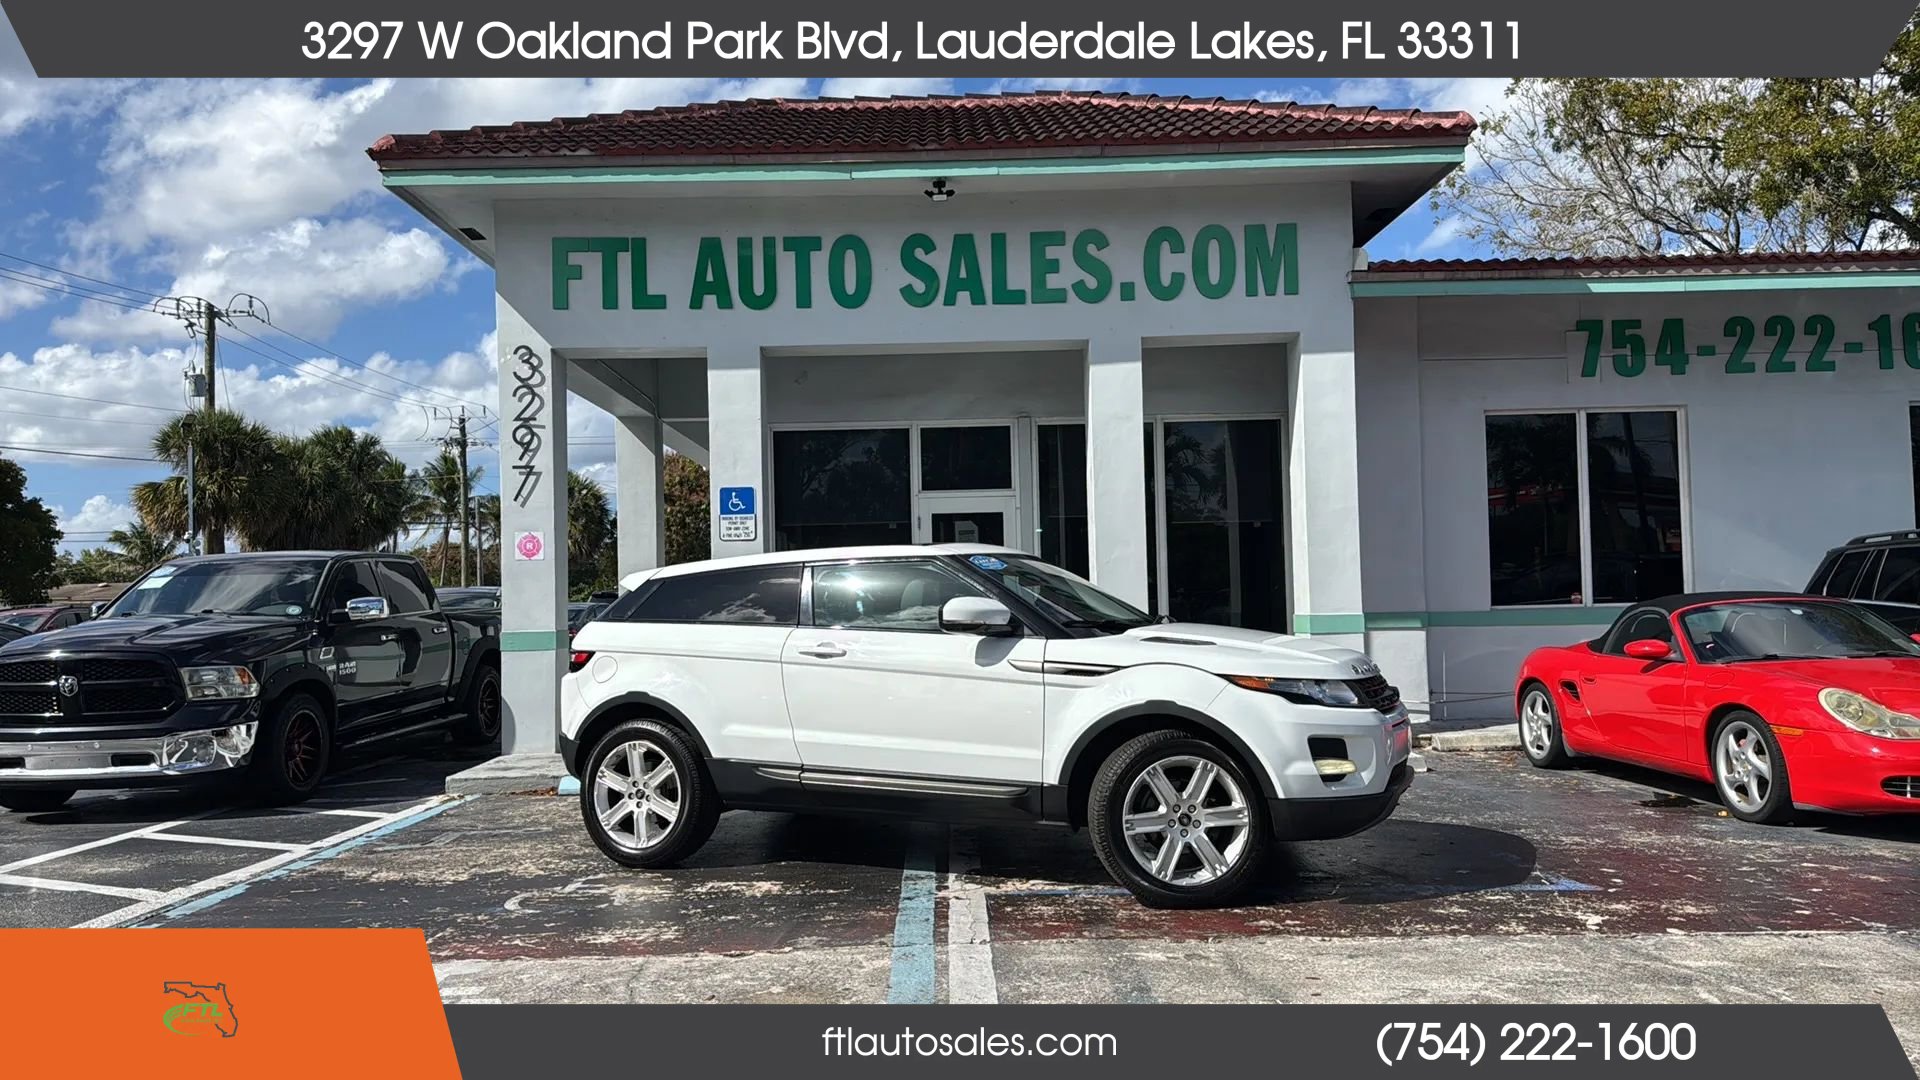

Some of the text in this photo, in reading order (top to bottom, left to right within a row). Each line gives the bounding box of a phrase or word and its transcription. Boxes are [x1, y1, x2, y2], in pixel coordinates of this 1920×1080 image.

[551, 223, 1300, 311] FTL AUTO SALES.COM
[512, 345, 537, 502] 3297
[526, 542, 533, 550] R
